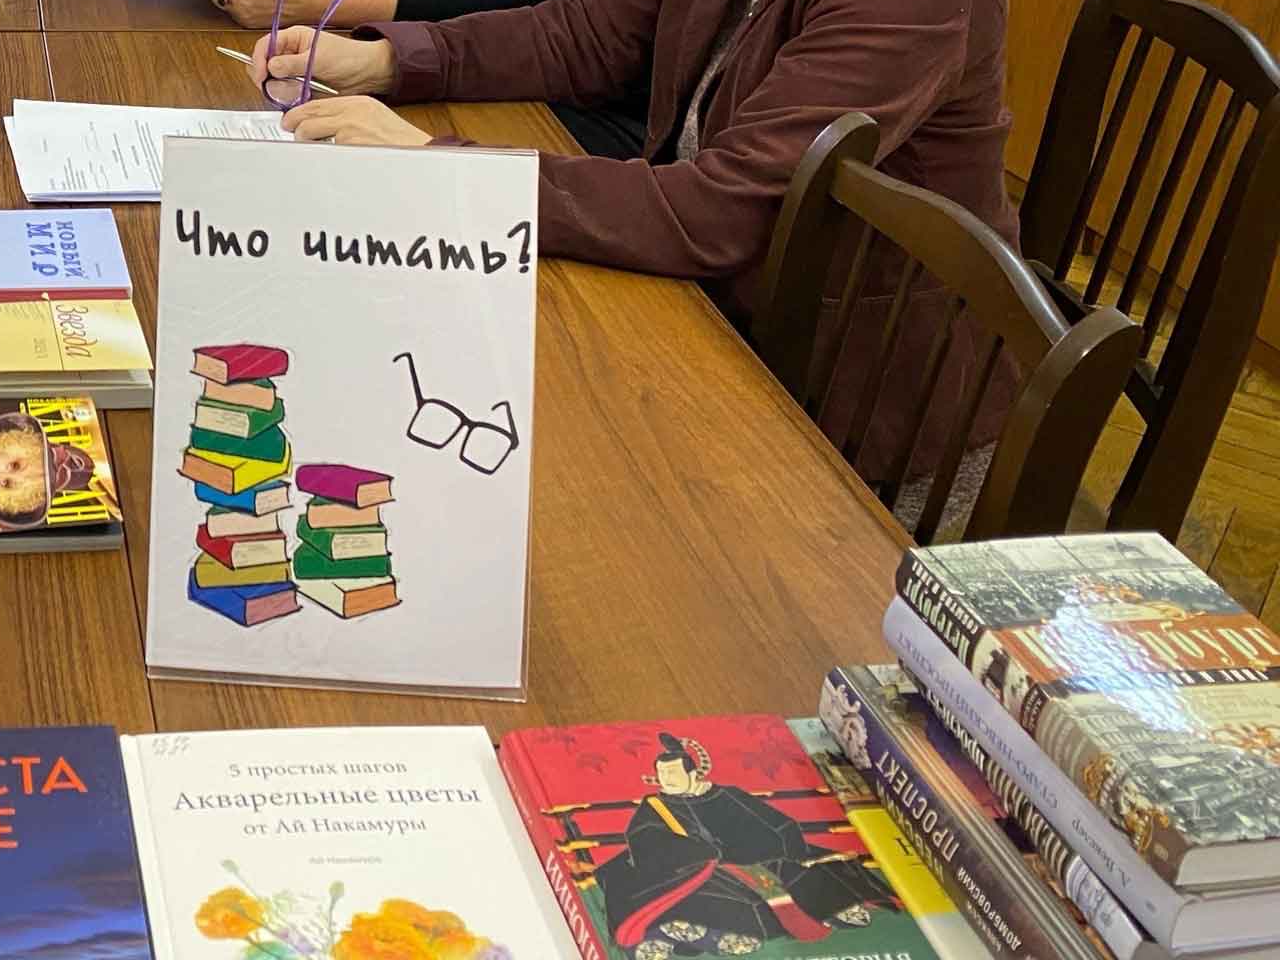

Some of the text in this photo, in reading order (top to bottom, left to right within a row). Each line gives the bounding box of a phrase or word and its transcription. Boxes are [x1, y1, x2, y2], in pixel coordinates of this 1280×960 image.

[26, 222, 59, 278] МИР
[56, 220, 89, 279] НОВЫЙ
[175, 208, 533, 275] Что читать?
[55, 305, 97, 359] Звезда
[25, 397, 111, 526] КАРАН
[229, 761, 408, 781] 5 простых шагов
[173, 786, 481, 815] Акварельные цветы
[243, 816, 428, 838] от Ай Накамуры
[875, 751, 960, 862] ПРОСПЕКТ
